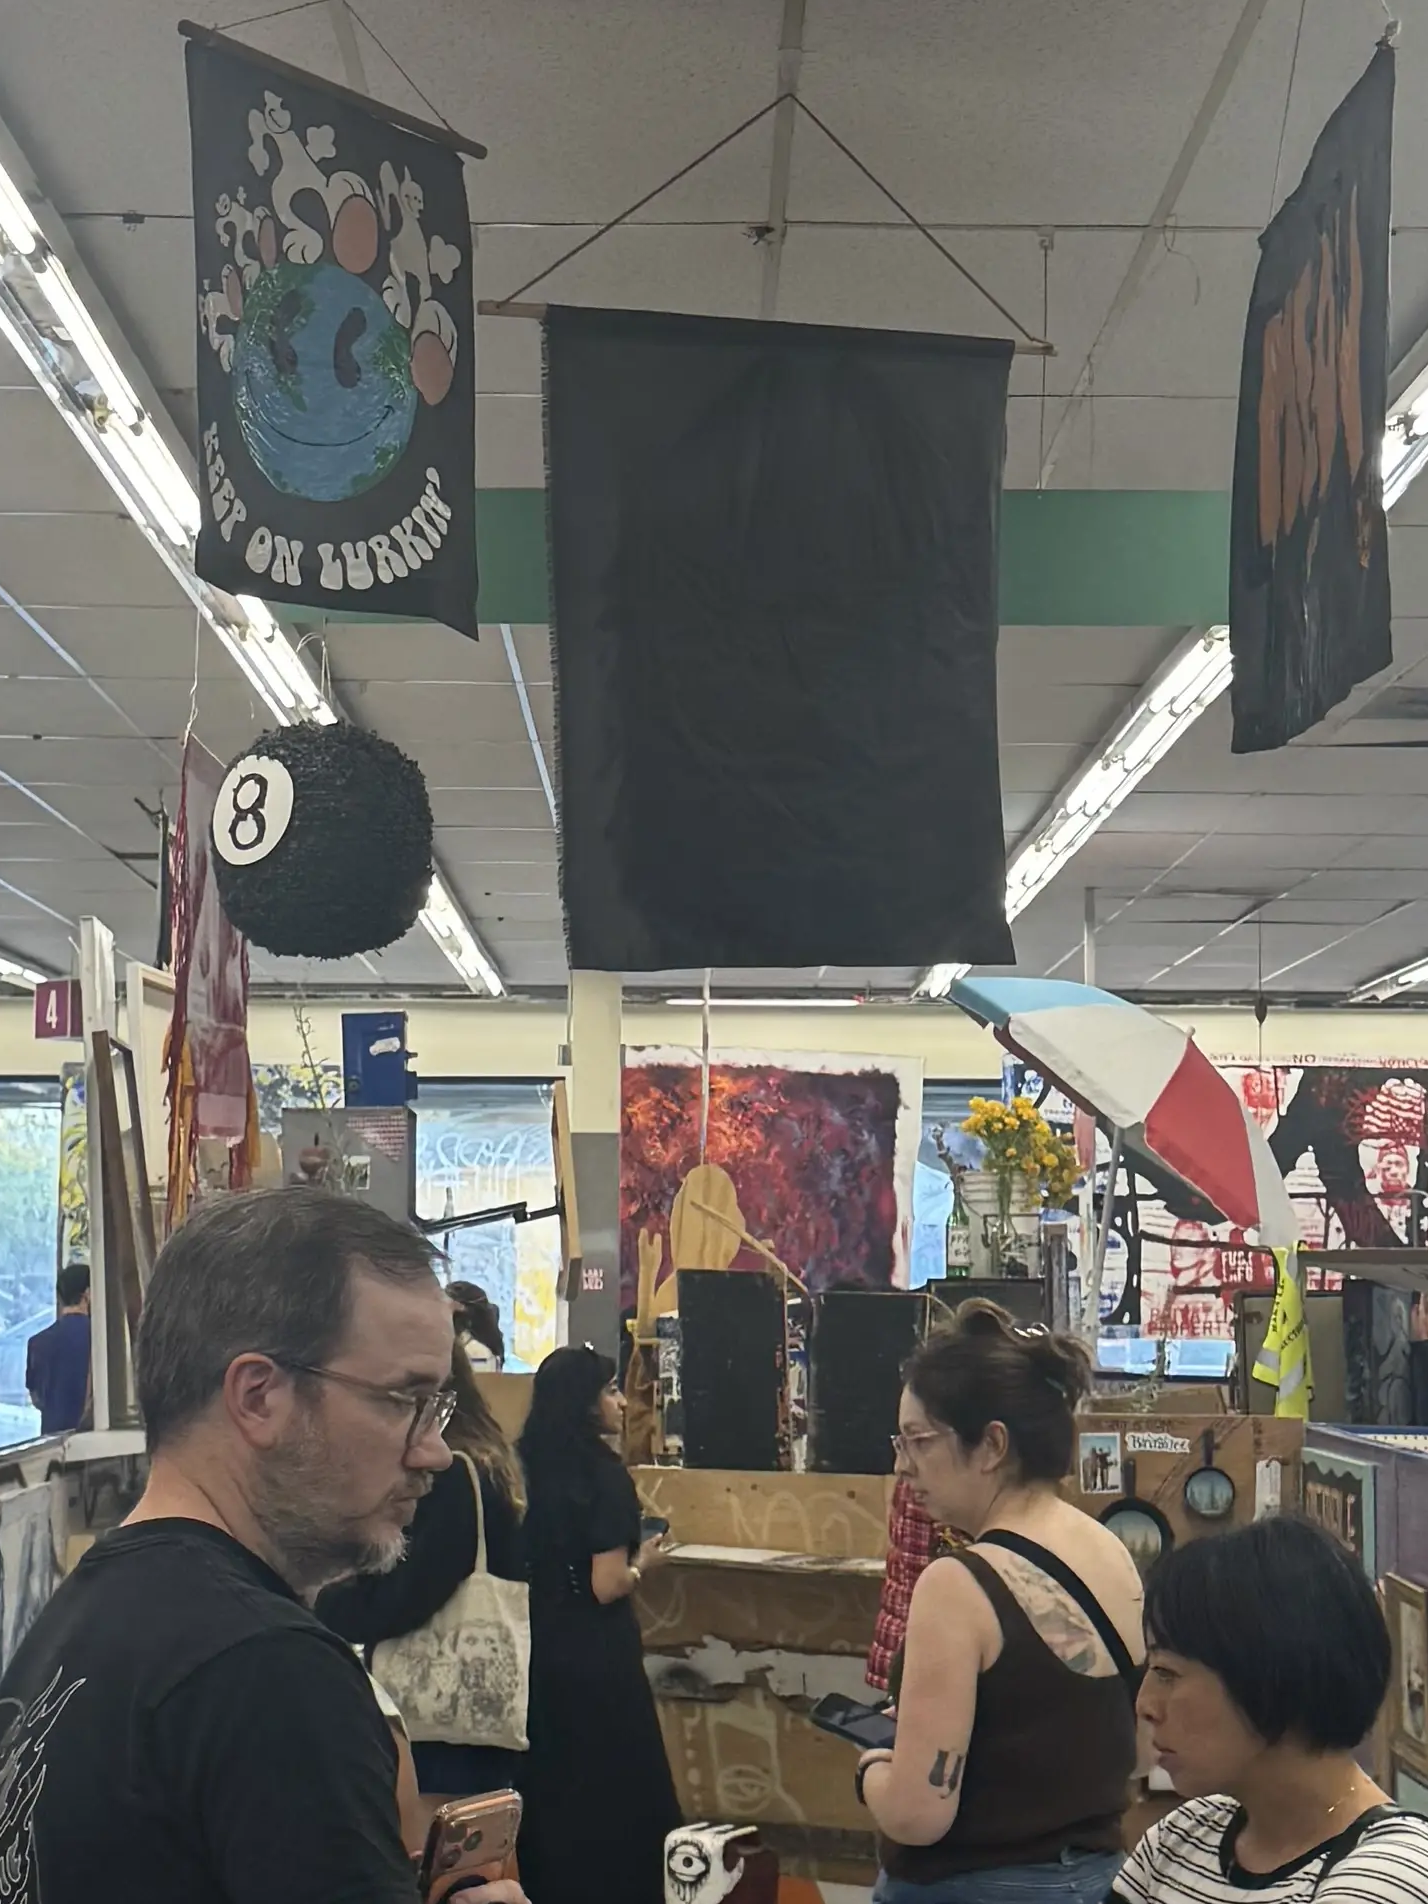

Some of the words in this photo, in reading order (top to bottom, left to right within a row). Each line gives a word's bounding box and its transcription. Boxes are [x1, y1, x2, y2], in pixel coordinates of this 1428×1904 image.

[203, 421, 247, 542] KEEP
[245, 526, 304, 587] ON
[318, 467, 452, 590] LURKIN'
[230, 772, 270, 852] 8
[45, 989, 59, 1029] 4
[1293, 1054, 1317, 1063] NO
